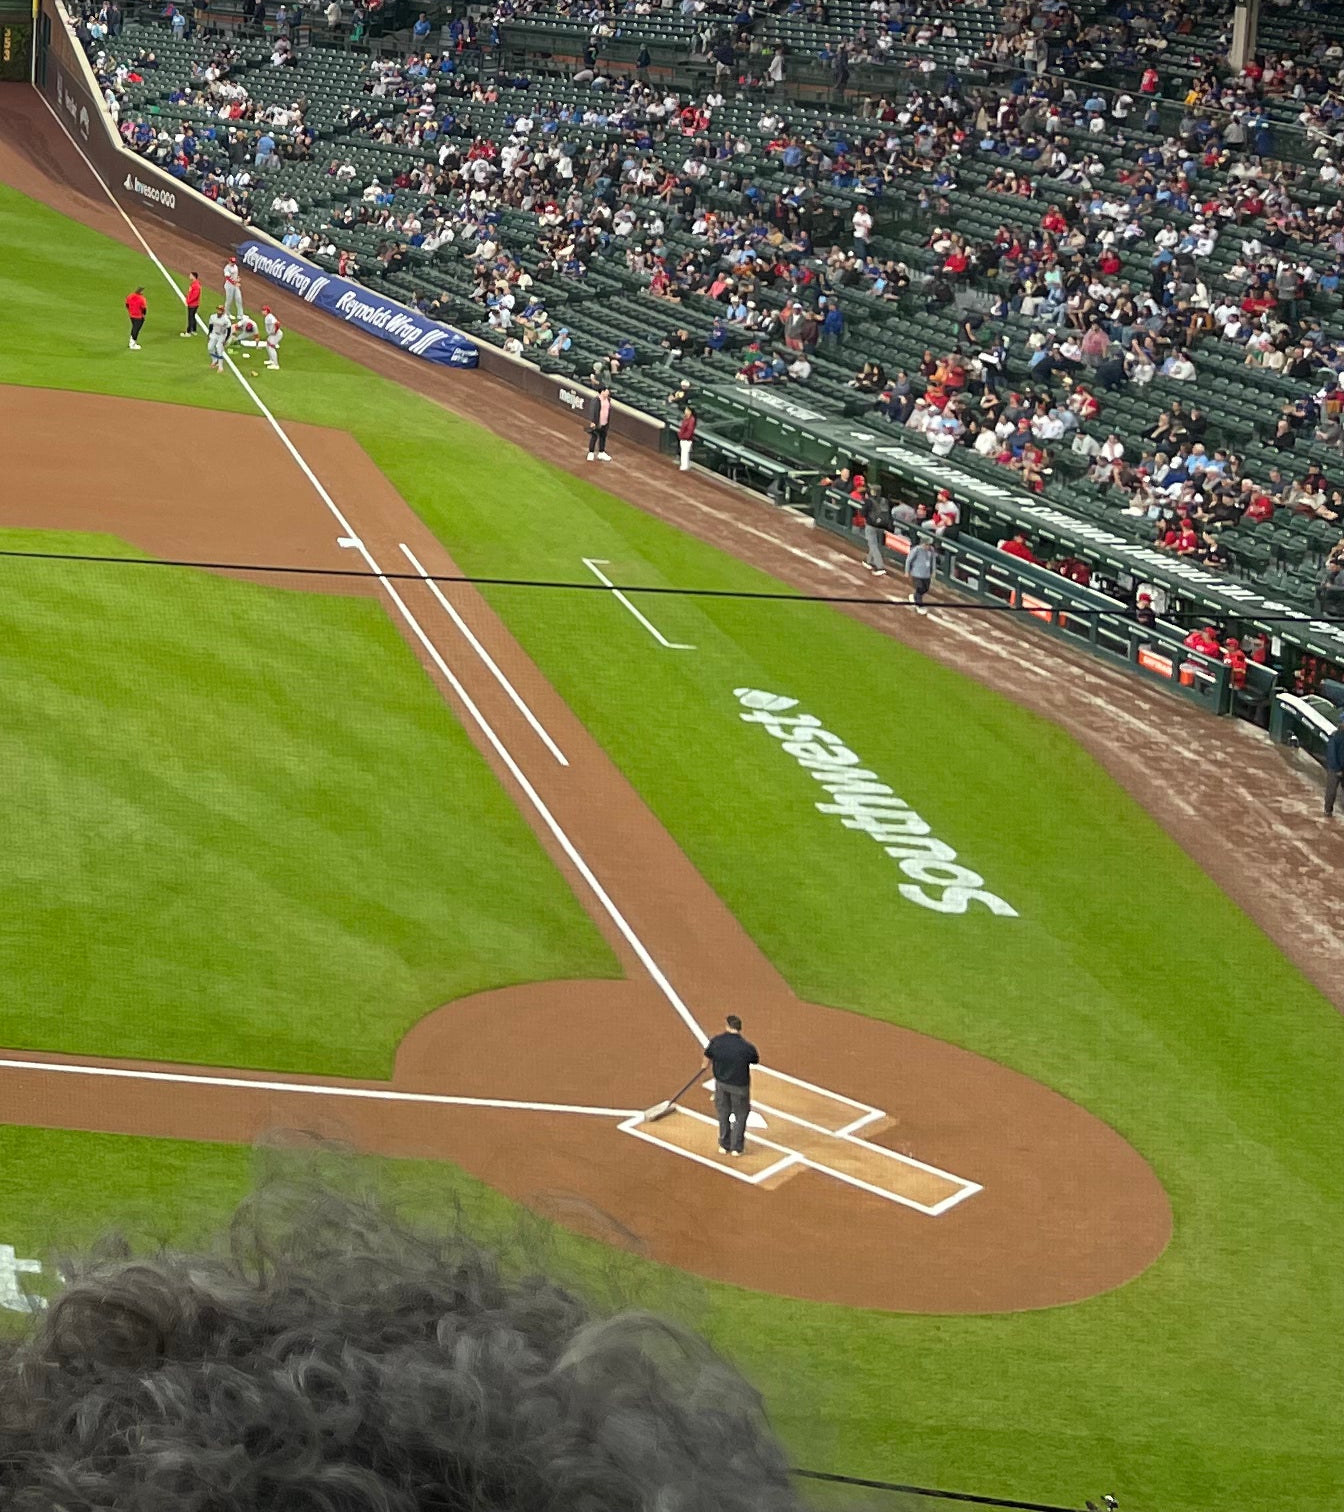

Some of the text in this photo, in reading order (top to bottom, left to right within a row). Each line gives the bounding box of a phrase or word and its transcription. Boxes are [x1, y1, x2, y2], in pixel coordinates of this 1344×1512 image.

[242, 245, 311, 295] Reynolds Wrap
[335, 290, 423, 346] Reynolds Wrap
[740, 709, 1020, 917] Southwest
